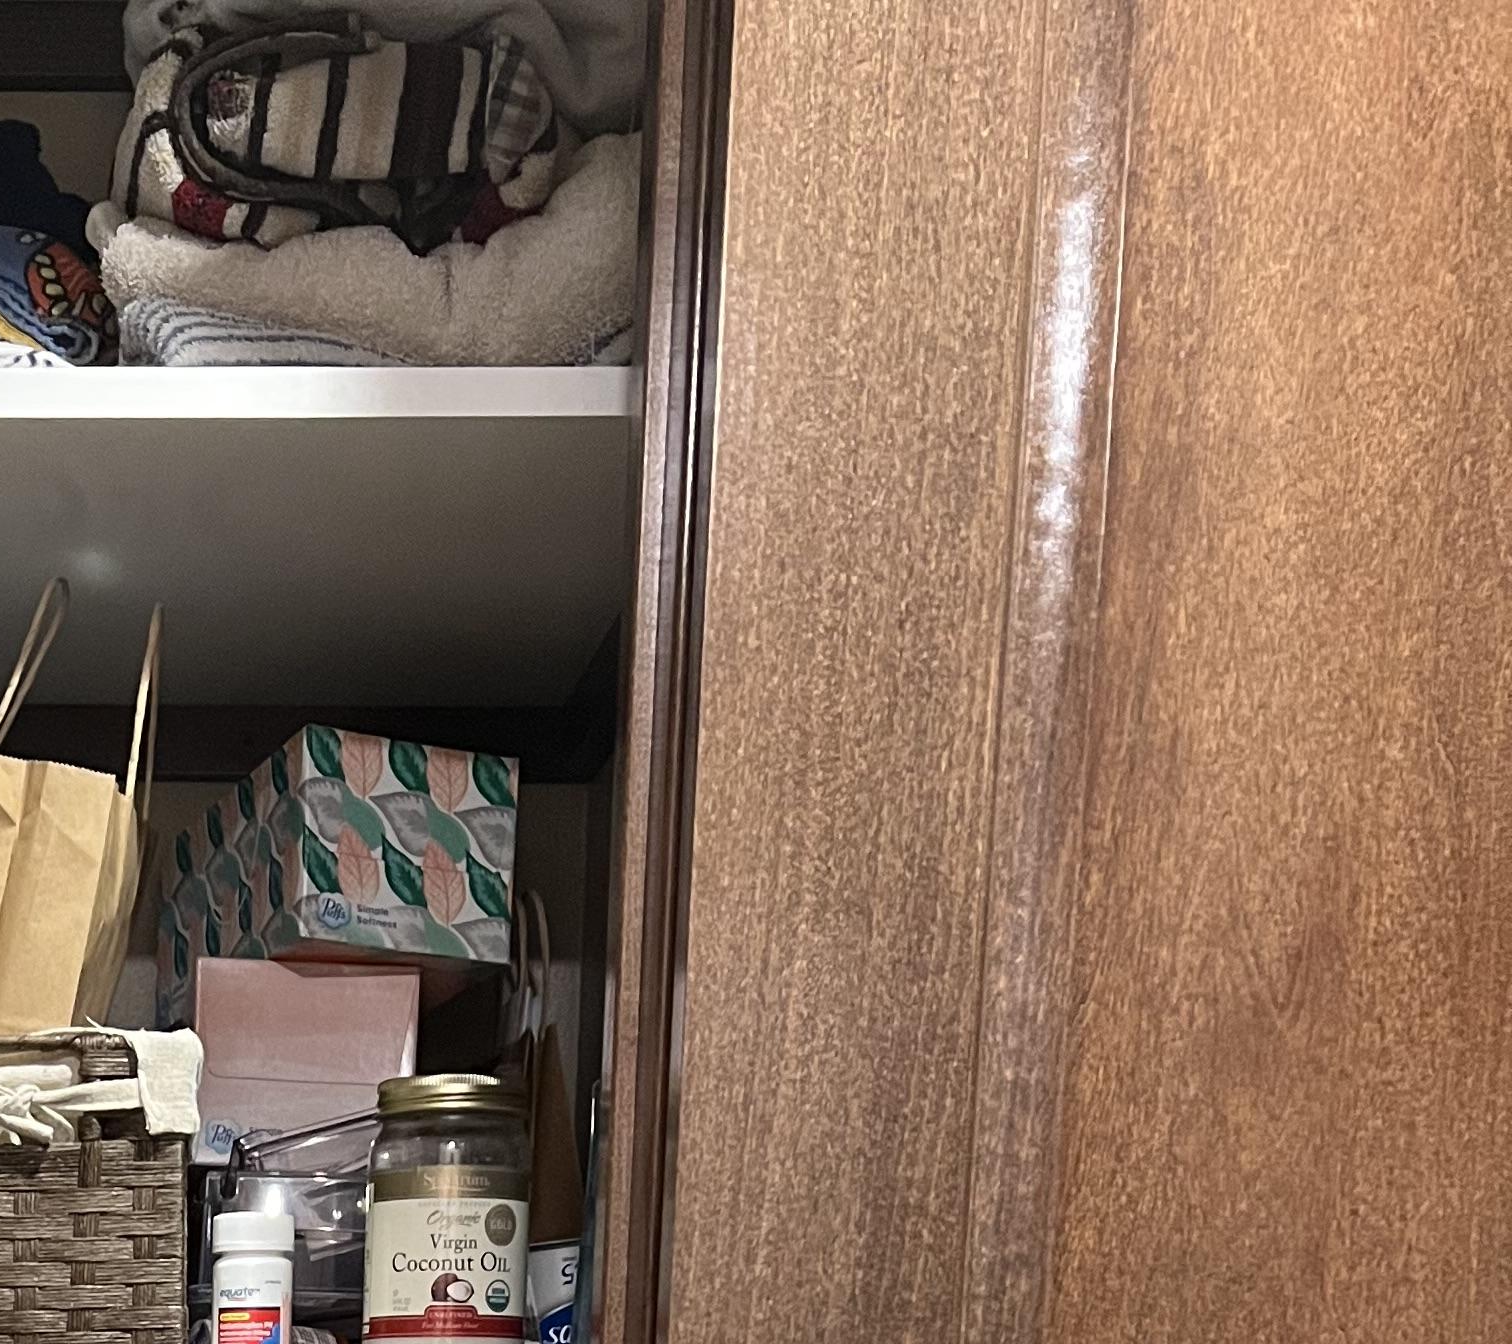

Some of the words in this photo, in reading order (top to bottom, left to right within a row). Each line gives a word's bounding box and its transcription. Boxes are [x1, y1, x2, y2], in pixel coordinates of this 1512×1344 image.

[322, 898, 346, 919] Puffs
[430, 1234, 478, 1254] Virgin
[392, 1252, 474, 1272] Coconut
[481, 1251, 511, 1272] OIL
[220, 1288, 254, 1300] equate
